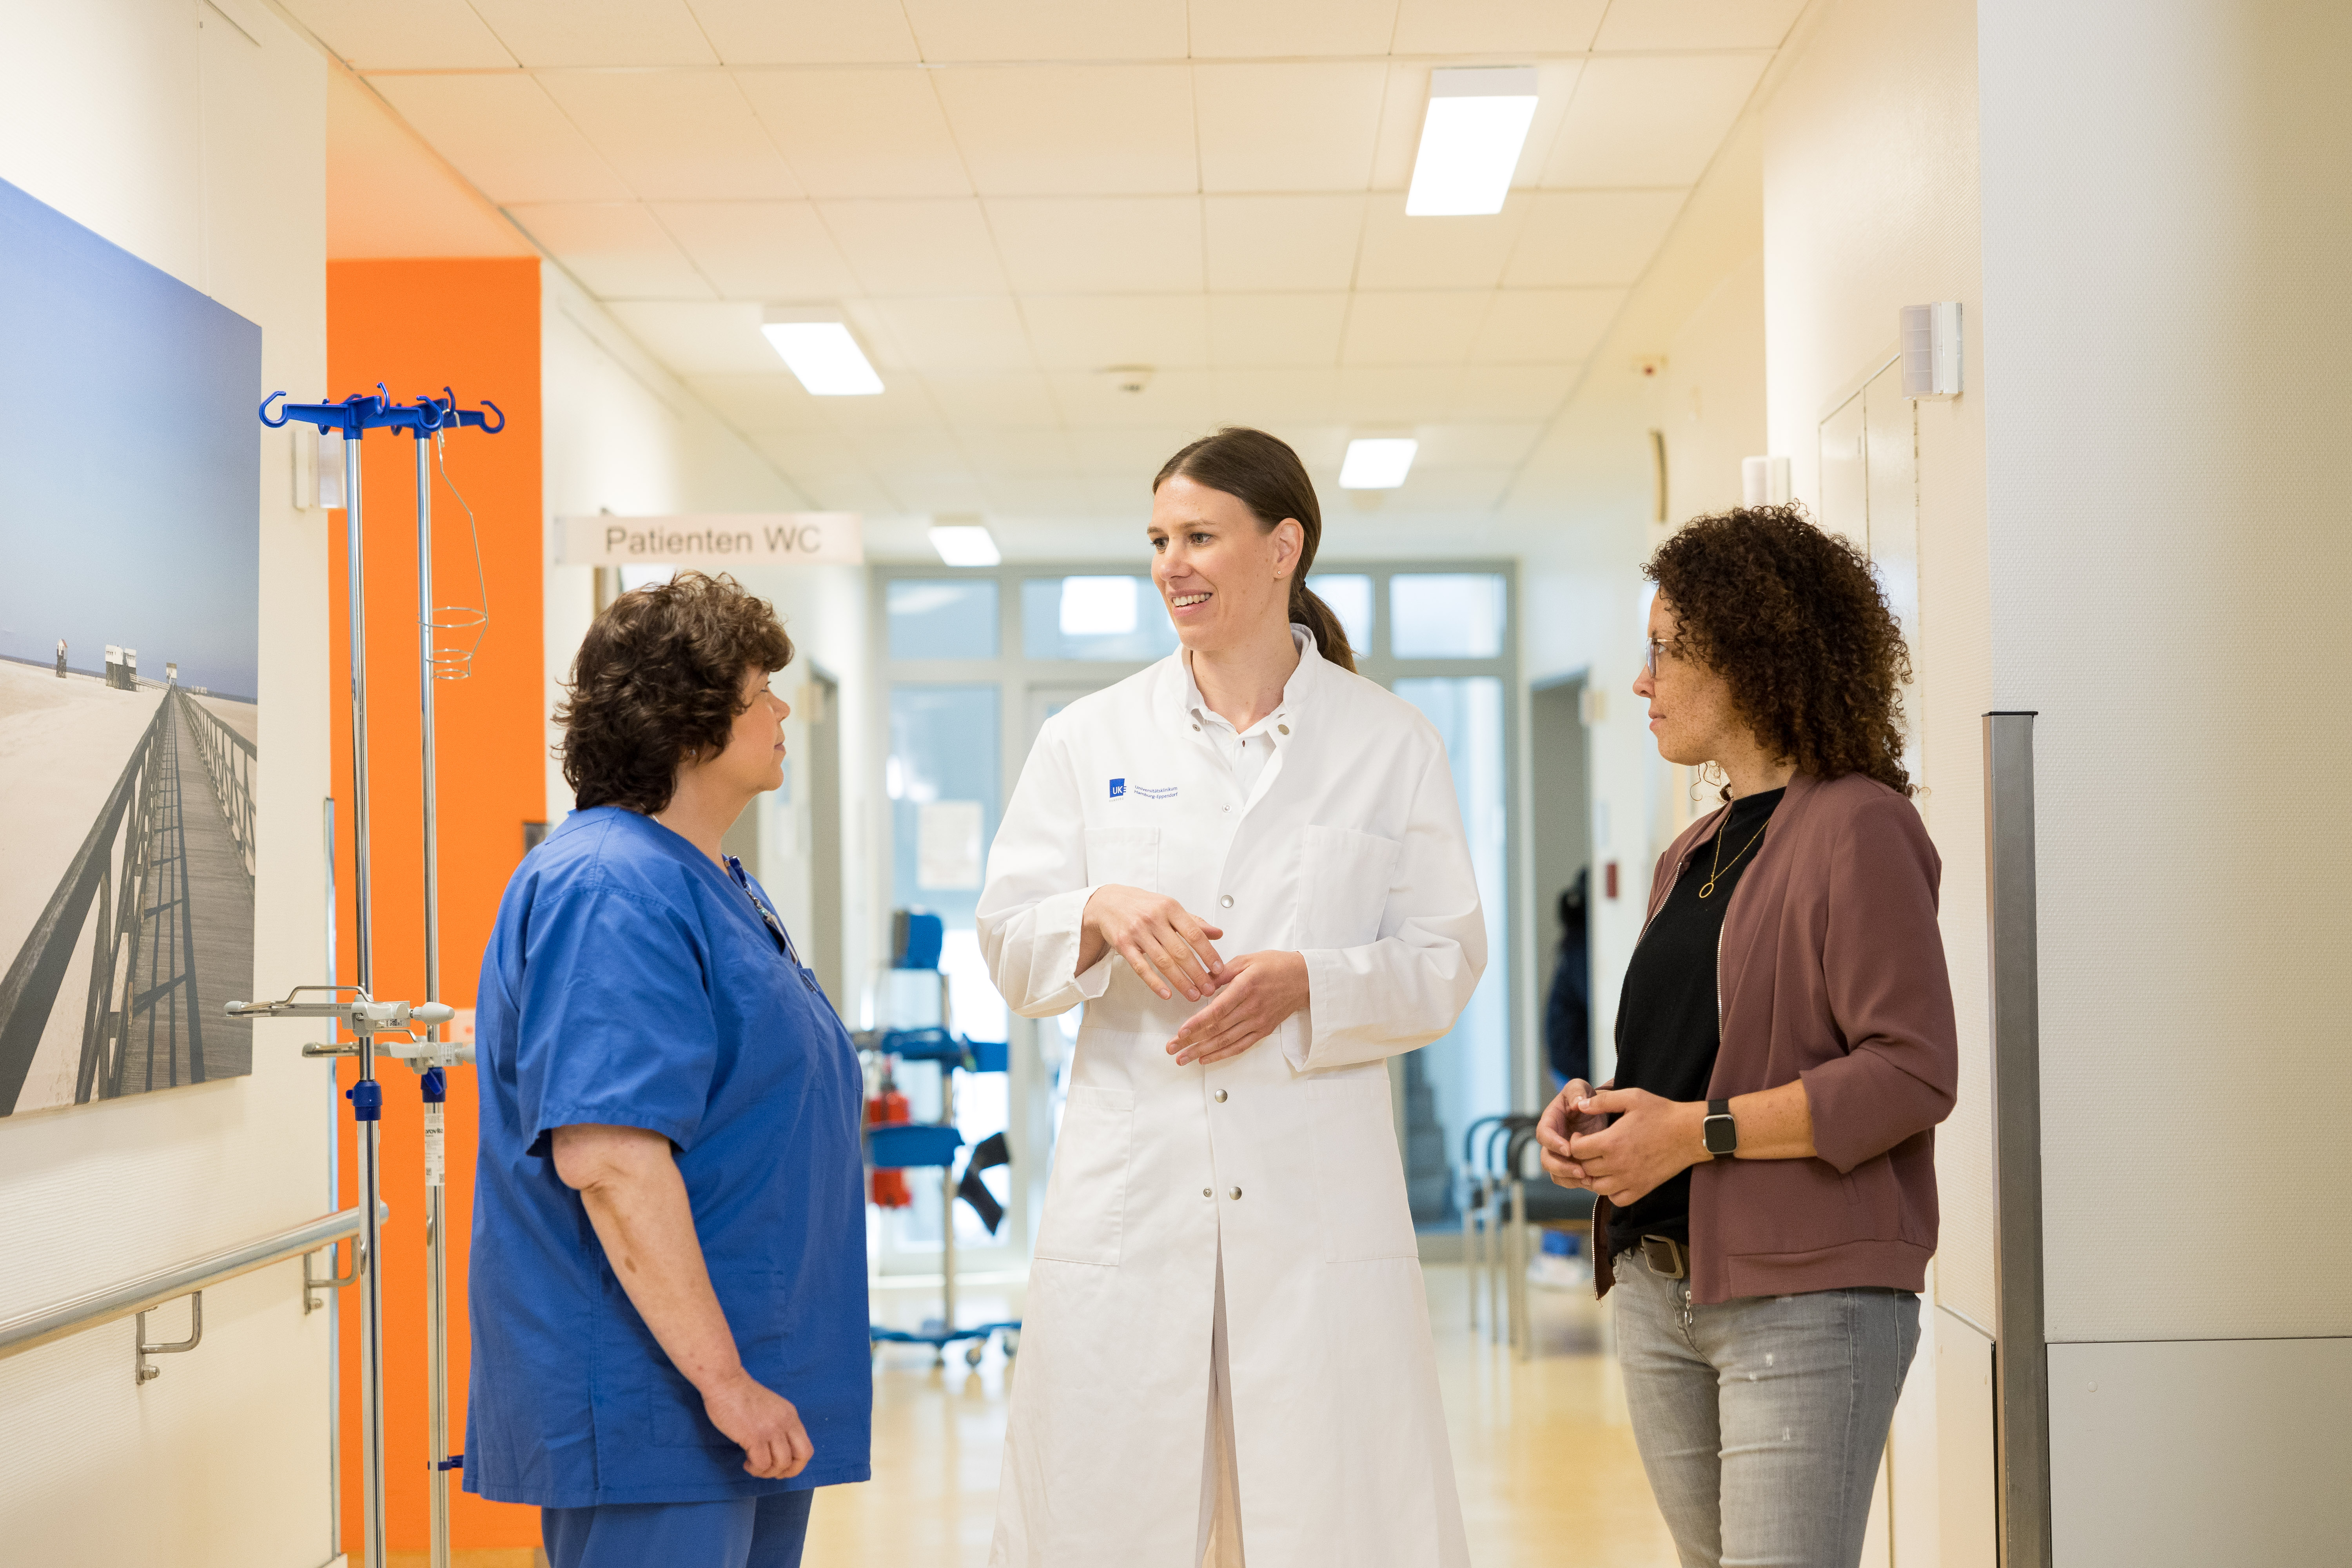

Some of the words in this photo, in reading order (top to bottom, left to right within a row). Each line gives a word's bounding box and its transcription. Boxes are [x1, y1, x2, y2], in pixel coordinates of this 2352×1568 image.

[605, 524, 753, 555] Patienten
[764, 523, 822, 554] WC
[1112, 786, 1127, 795] UKE
[1135, 785, 1178, 793] Universitätsklinikum
[1134, 790, 1178, 799] Hamburg-Eppendorf
